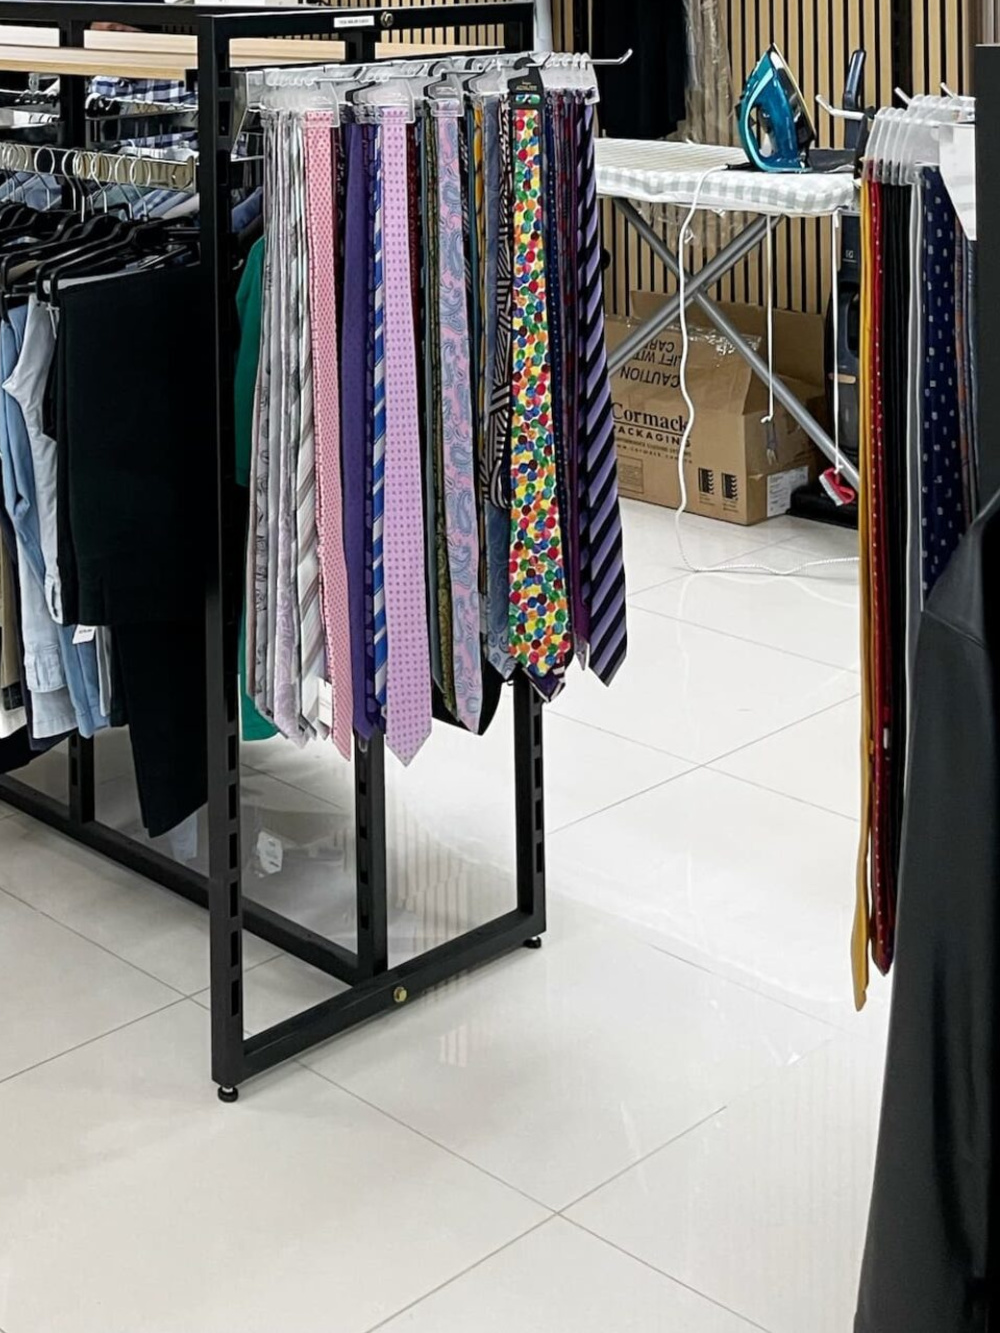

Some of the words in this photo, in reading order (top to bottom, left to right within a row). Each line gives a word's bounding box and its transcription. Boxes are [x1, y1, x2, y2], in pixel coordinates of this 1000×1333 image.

[632, 350, 655, 364] WIT
[658, 353, 682, 366] IFT
[620, 366, 681, 388] CAUTION
[611, 402, 690, 433] Cormack
[613, 424, 691, 448] ACKAGING
